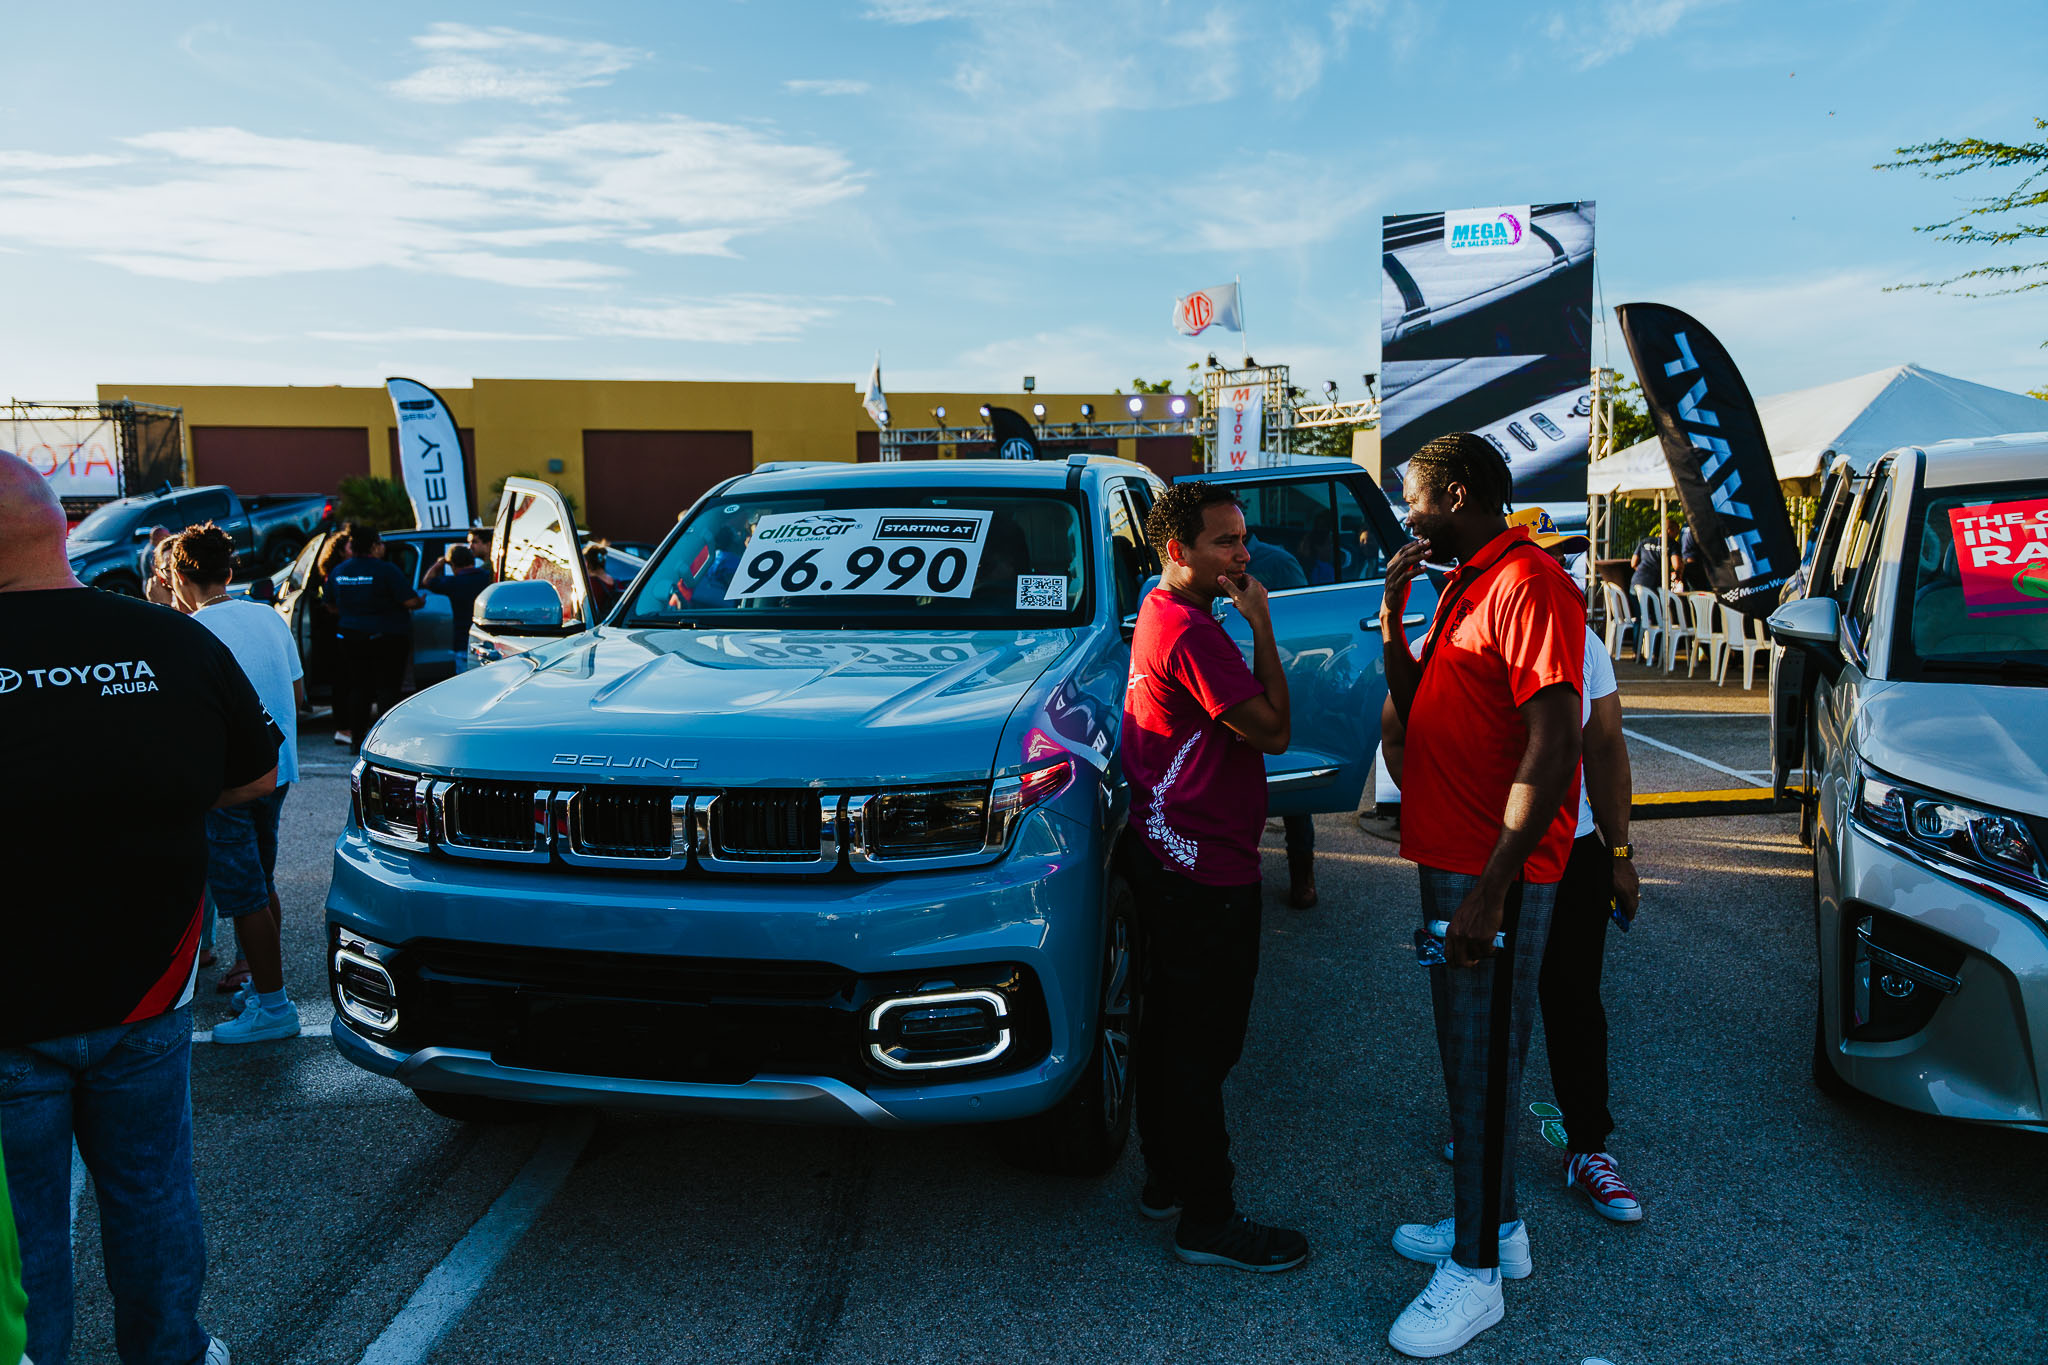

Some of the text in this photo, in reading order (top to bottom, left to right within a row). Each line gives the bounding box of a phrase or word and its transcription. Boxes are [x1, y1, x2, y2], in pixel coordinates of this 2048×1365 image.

[1452, 222, 1507, 241] MEGA
[1467, 239, 1489, 247] SALES
[1491, 238, 1508, 246] 2025
[1184, 295, 1211, 327] MG
[1232, 388, 1250, 445] MOTOR
[16, 443, 115, 476] OTA
[1663, 331, 1772, 583] HAVAL
[418, 434, 451, 530] EELY
[884, 524, 972, 534] STARTING AT
[1956, 512, 2026, 529] THE
[1963, 526, 2013, 546] IN
[740, 546, 968, 594] 96.990
[27, 660, 155, 688] TOYOTA
[101, 681, 159, 696] ARUBA
[551, 753, 699, 769] BEIJING
